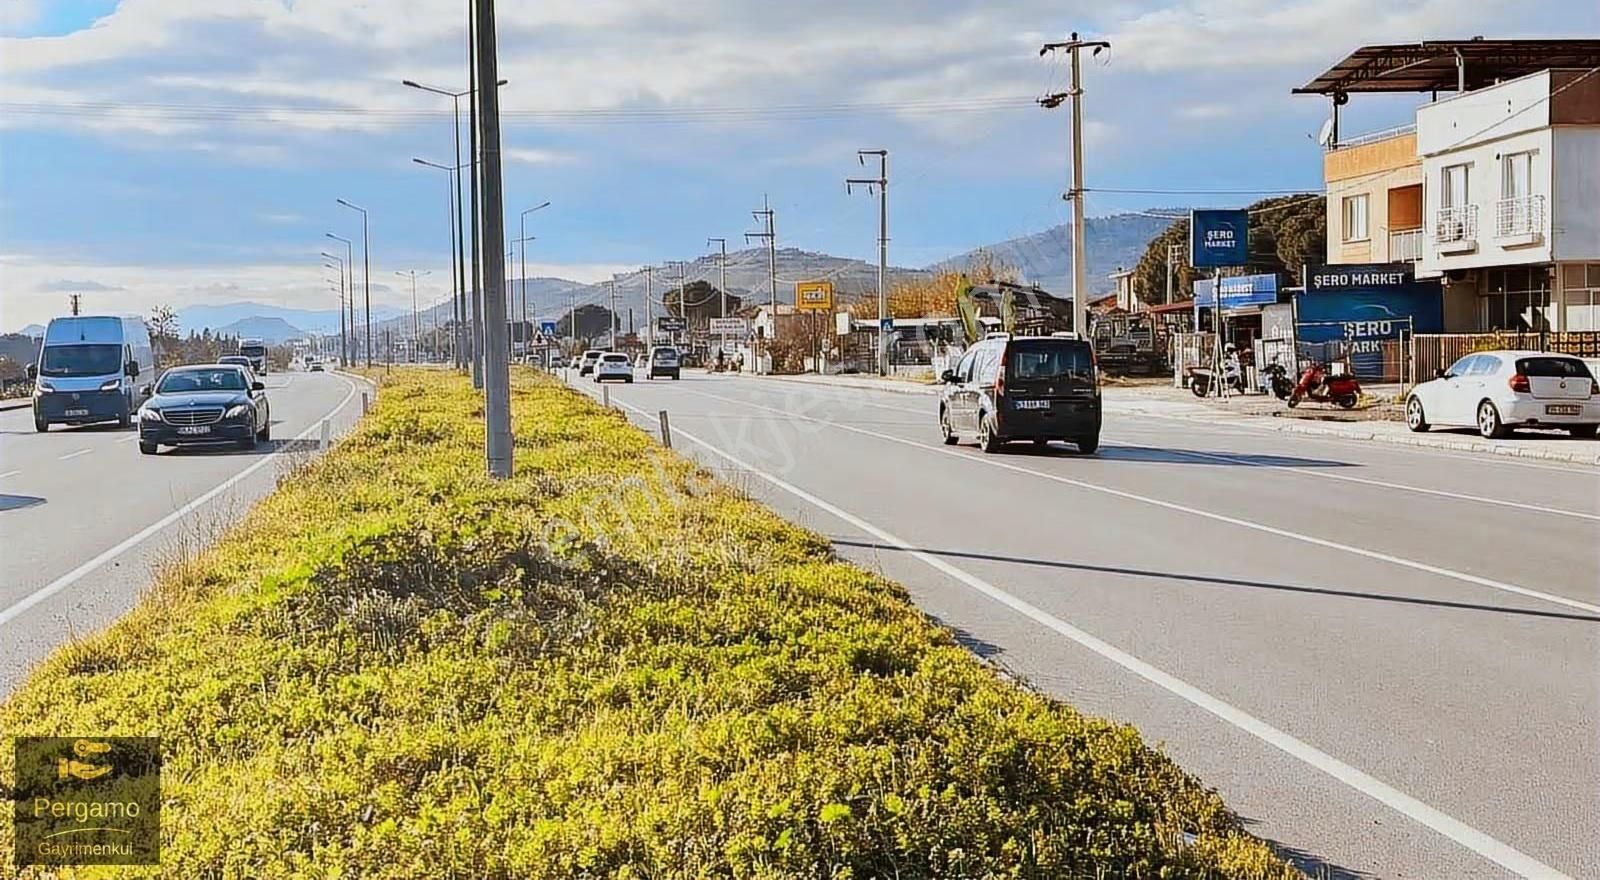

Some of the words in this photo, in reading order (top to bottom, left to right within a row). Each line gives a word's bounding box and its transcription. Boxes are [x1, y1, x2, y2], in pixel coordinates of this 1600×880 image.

[1207, 230, 1233, 241] ŞERO
[1204, 240, 1236, 248] MARKET
[1314, 274, 1349, 289] ŞERO
[1352, 273, 1405, 286] MARKET
